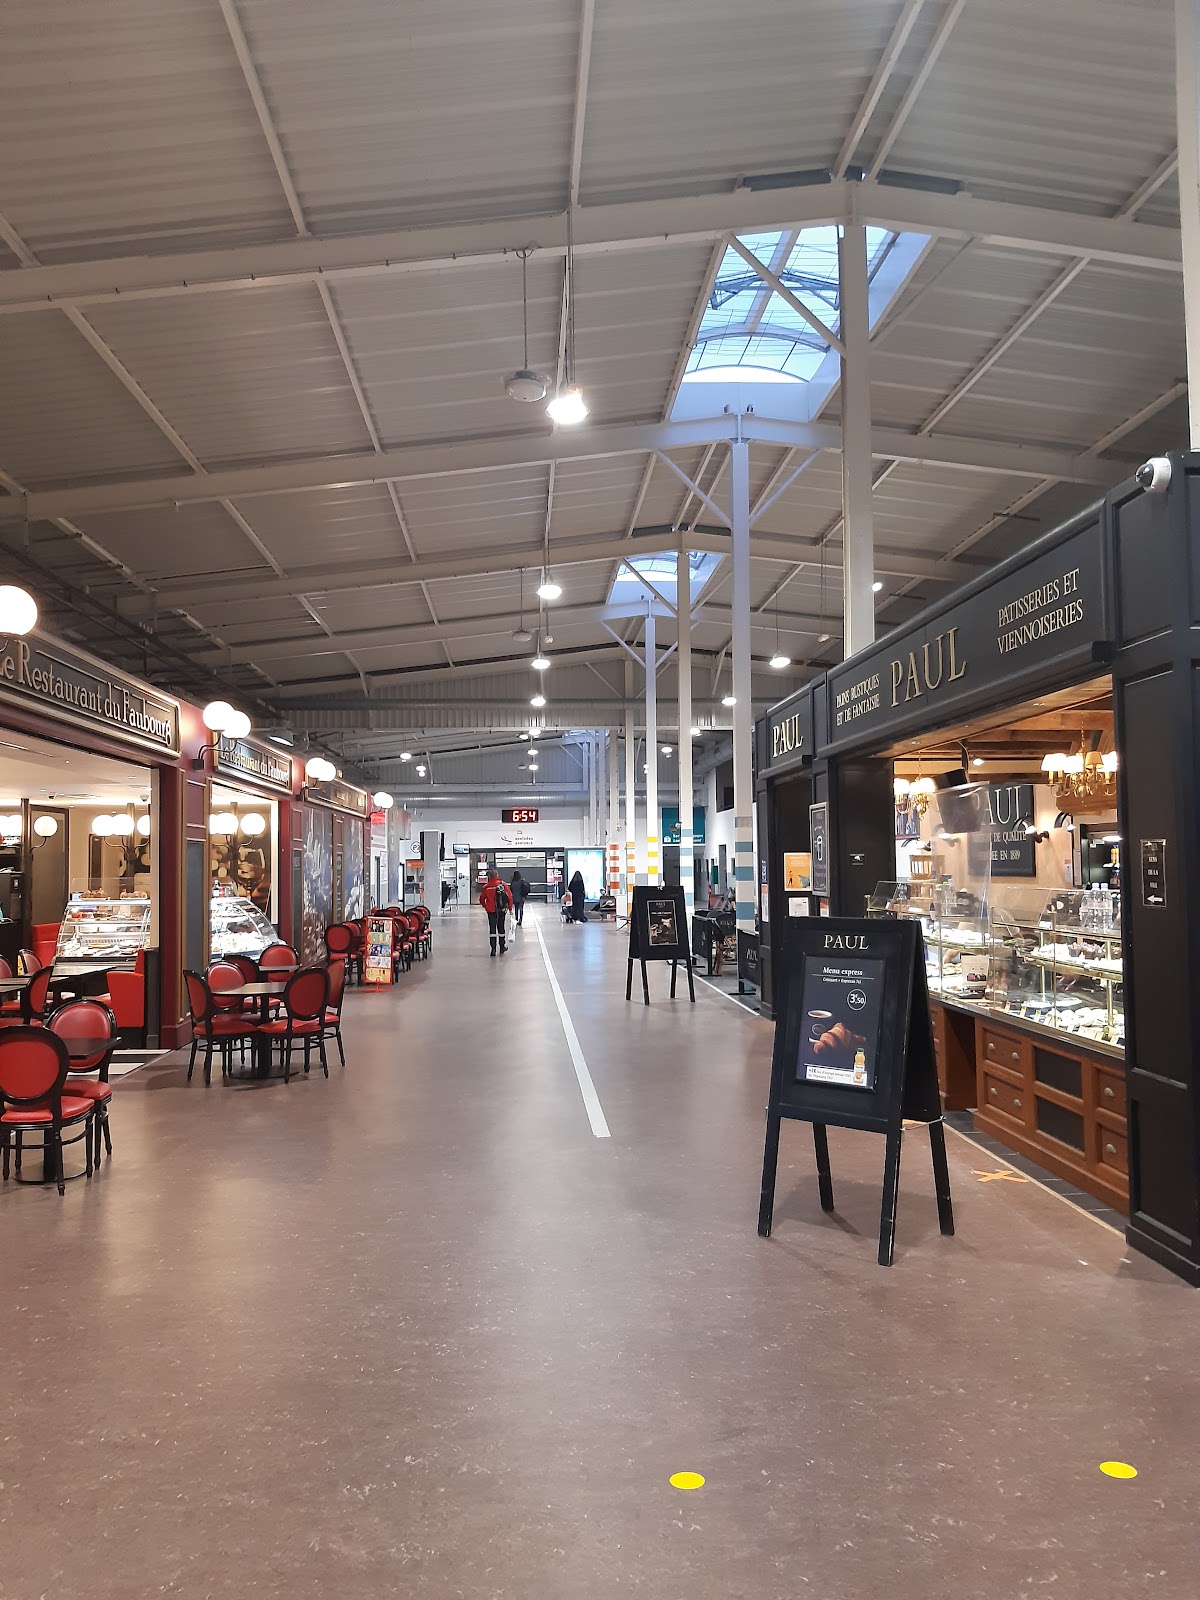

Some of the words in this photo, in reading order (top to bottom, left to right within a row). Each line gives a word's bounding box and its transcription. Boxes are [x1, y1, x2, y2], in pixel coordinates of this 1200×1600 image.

[998, 579, 1060, 628] PATISSERIES
[1062, 568, 1080, 596] ET
[997, 599, 1084, 654] VIENNOISERIES
[890, 627, 967, 707] PAUL
[17, 640, 102, 714] Restaurant
[104, 682, 121, 721] du
[122, 689, 172, 747] Faubourg
[836, 690, 850, 708] PAINS
[850, 673, 880, 701] RUSTIQUES
[836, 711, 844, 727] ET
[844, 707, 852, 723] DE
[852, 693, 880, 719] FANTAISIE
[772, 713, 804, 758] PAUL
[512, 810, 536, 822] 6:54
[994, 832, 1001, 843] DE
[1000, 850, 1008, 860] EN
[823, 934, 870, 950] PAUL
[822, 966, 840, 974] Menu
[841, 969, 863, 977] express
